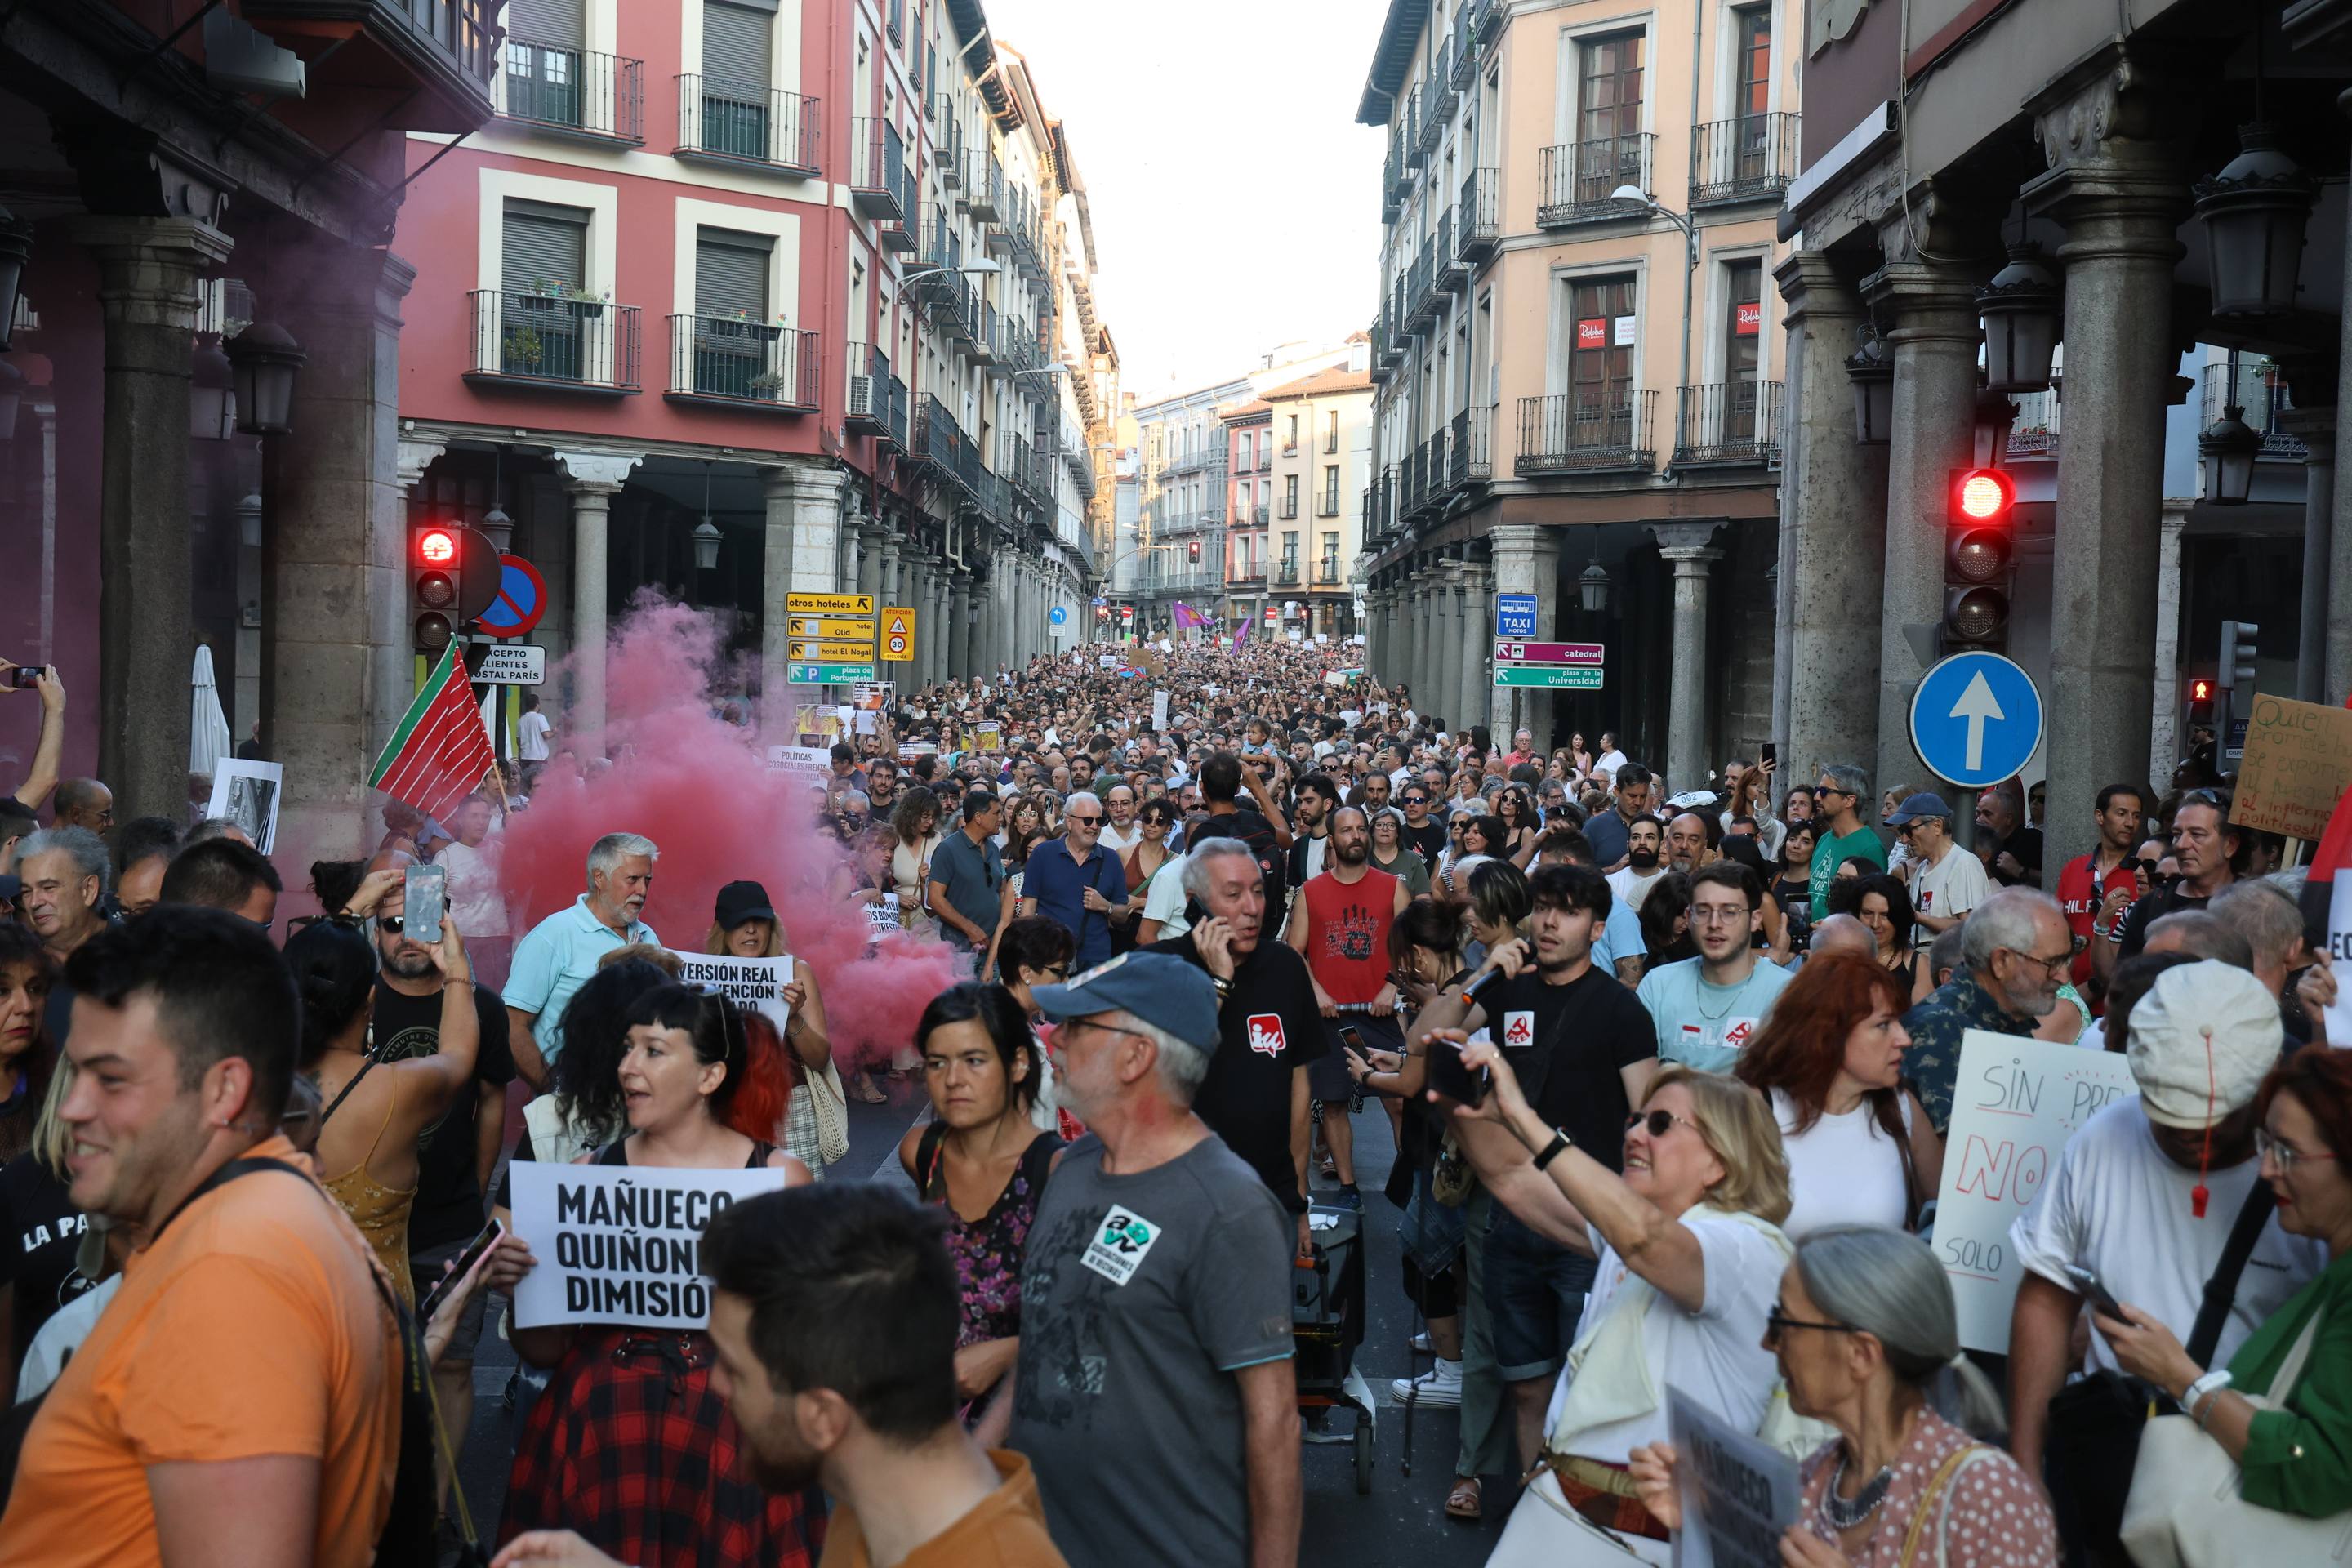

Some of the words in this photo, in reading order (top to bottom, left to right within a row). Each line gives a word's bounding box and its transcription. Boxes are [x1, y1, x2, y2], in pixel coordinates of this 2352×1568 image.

[789, 599, 813, 608] otros
[817, 599, 851, 608] hoteles
[1503, 618, 1530, 628] TAXI
[850, 648, 871, 657] Nogal
[1564, 649, 1601, 658] catedral
[509, 670, 539, 679] PARÍS
[808, 667, 818, 679] P
[842, 666, 858, 675] plaza
[830, 674, 871, 683] Portugalete
[1548, 675, 1601, 685] Universidad
[782, 751, 813, 761] POLÍTICAS
[1681, 794, 1698, 804] 092
[742, 966, 777, 983] REAL
[1508, 1033, 1527, 1044] PCE
[387, 1033, 421, 1058] GENUINE
[1977, 1058, 2044, 1113] SIN
[1956, 1134, 2047, 1205] NO
[24, 1225, 52, 1253] LA
[556, 1228, 702, 1276] QUIÑON
[1941, 1237, 2002, 1272] SOLO
[566, 1276, 712, 1320] DIMISIÓ
